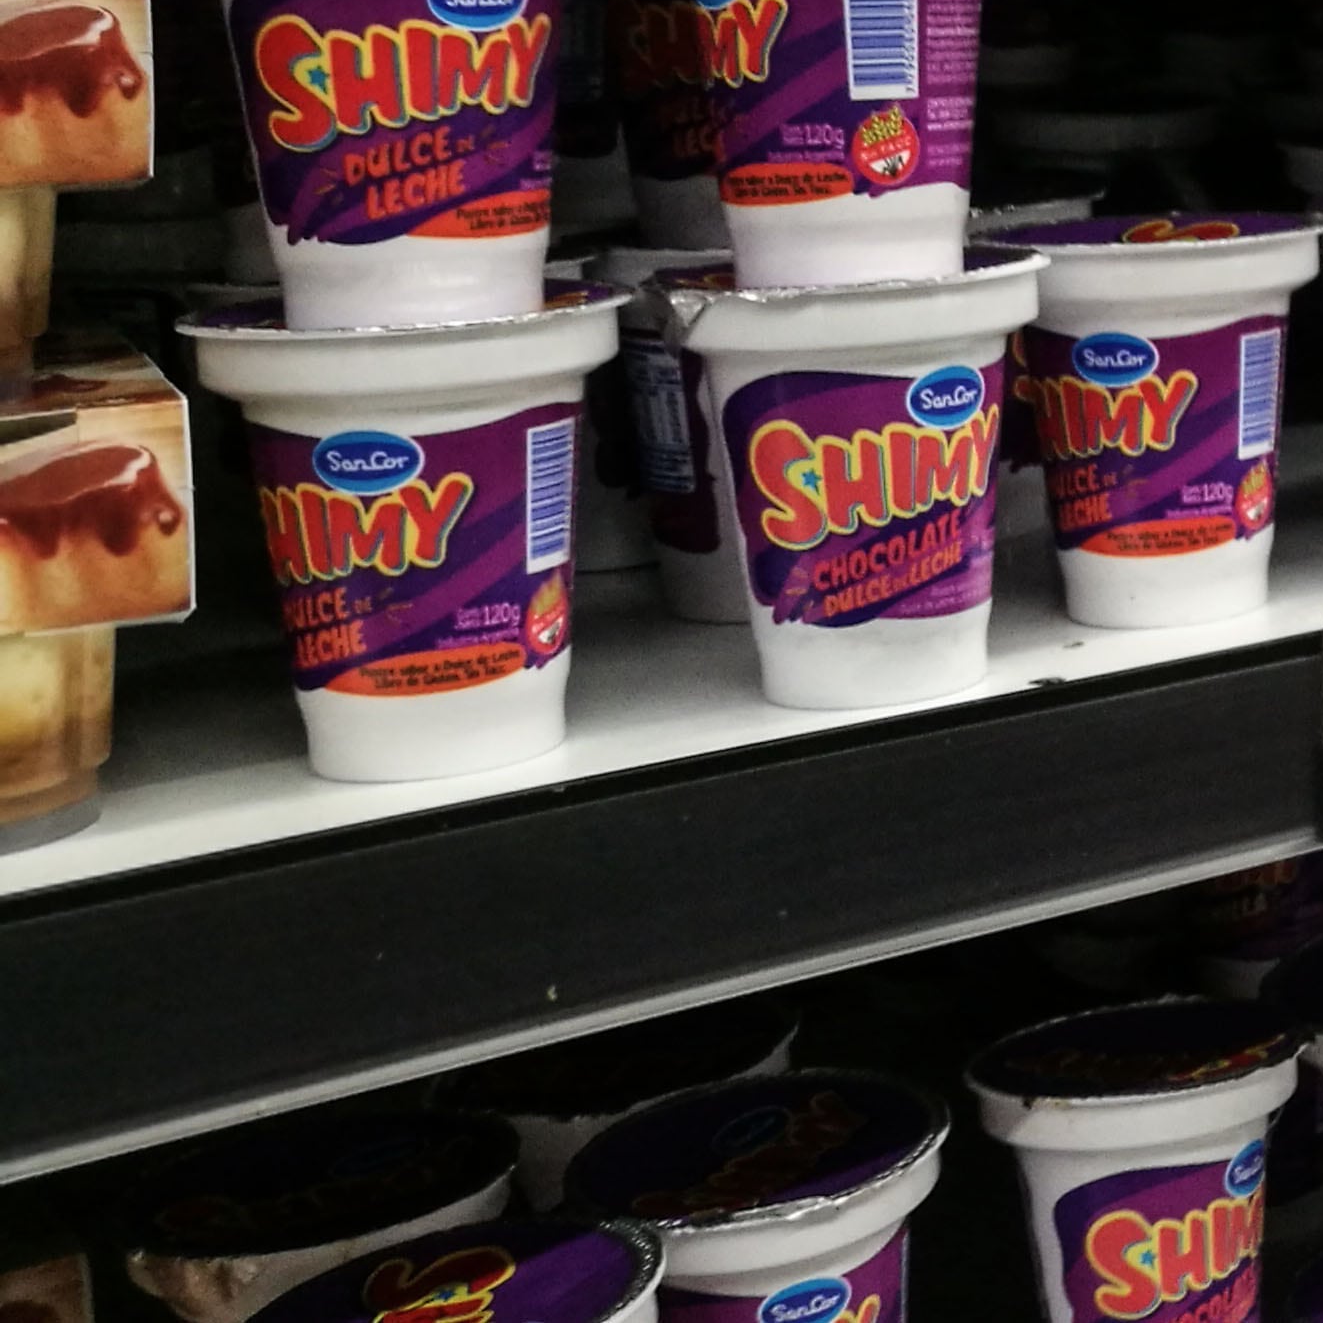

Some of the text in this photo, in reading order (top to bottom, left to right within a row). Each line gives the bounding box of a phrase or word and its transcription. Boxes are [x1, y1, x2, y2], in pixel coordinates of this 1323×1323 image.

[254, 13, 552, 152] SHIMY
[343, 126, 451, 187] DULCE
[366, 165, 466, 221] LECHE
[1082, 350, 1147, 370] SanCor
[920, 387, 978, 410] SanCor
[1036, 369, 1198, 460] HIMY
[327, 450, 409, 472] SanCor
[749, 404, 999, 551] SHIMY
[259, 472, 474, 585] HIMY
[813, 508, 962, 592] CHOCOLATE
[483, 602, 521, 625] 120g
[770, 1293, 841, 1323] SanCor
